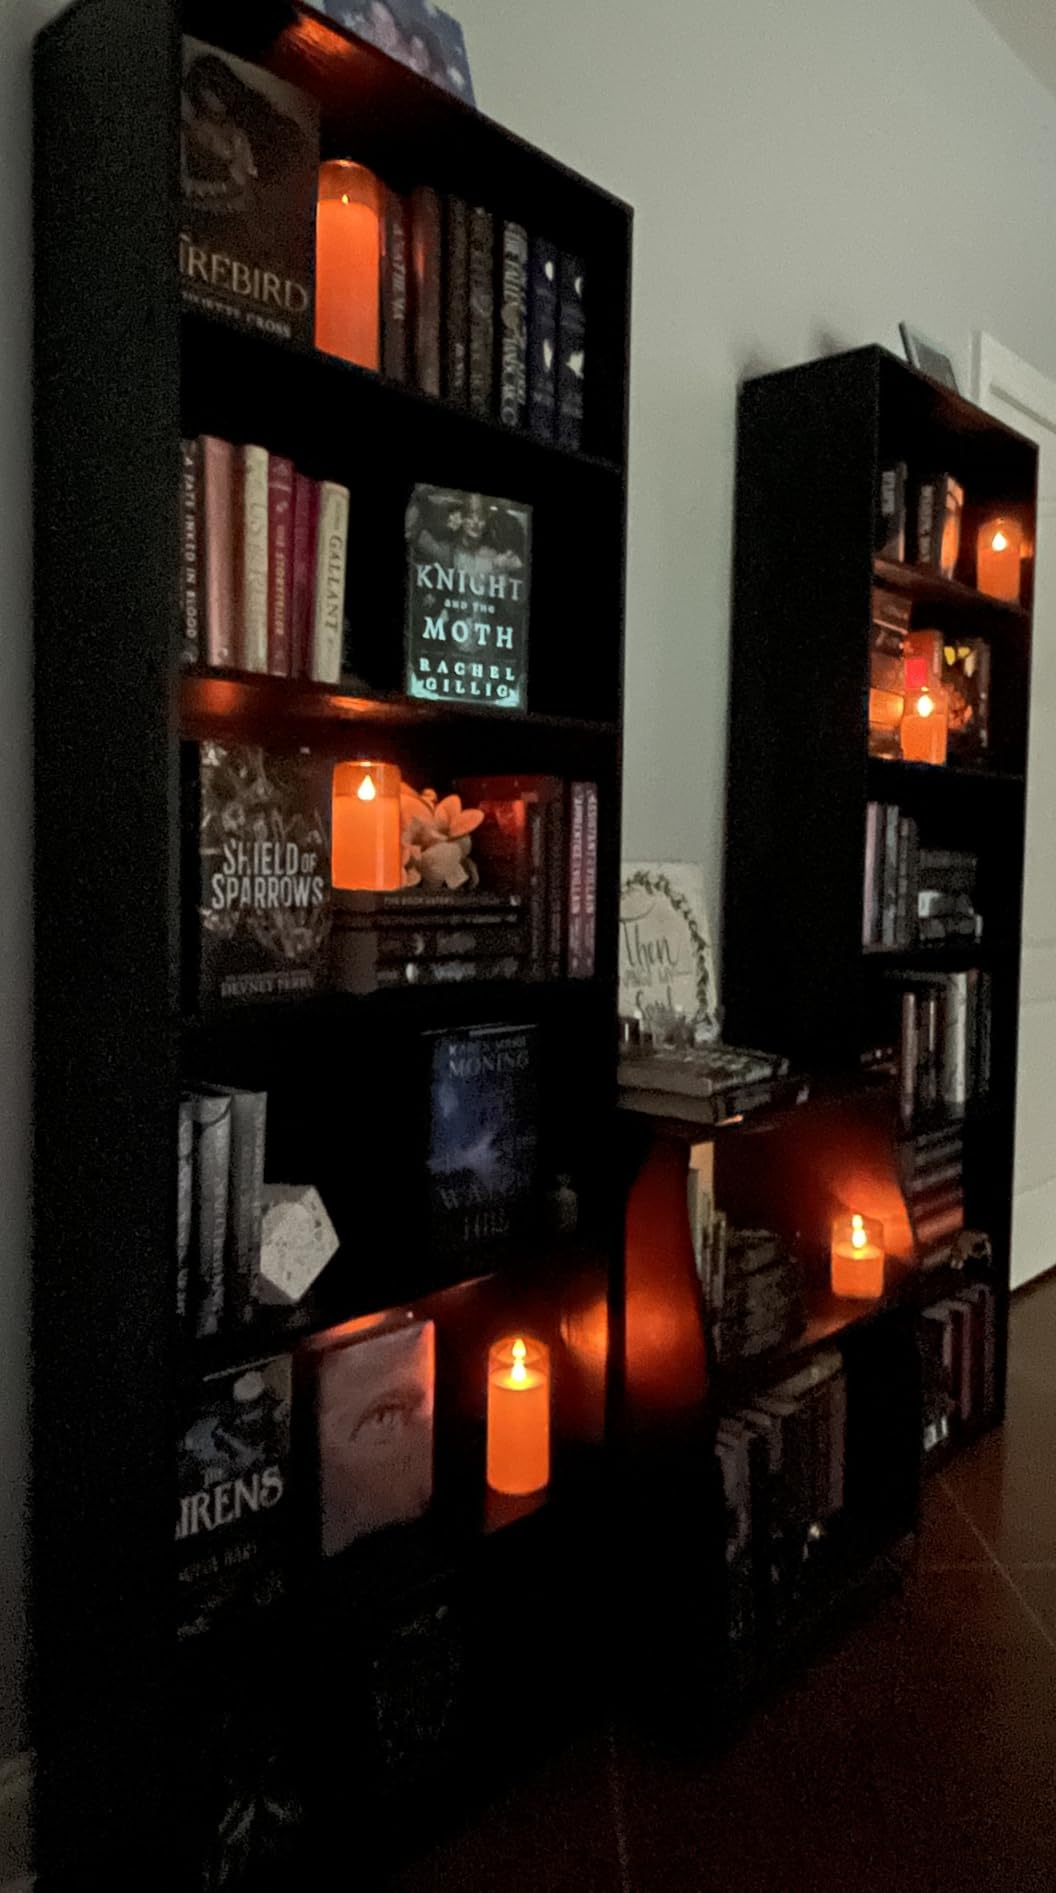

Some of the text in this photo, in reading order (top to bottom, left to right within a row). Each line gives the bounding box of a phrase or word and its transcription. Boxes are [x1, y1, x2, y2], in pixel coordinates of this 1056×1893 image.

[179, 232, 309, 313] IREBIRD
[186, 567, 197, 585] IN
[324, 534, 344, 632] GALLANT
[416, 562, 523, 601] KNIGHT
[186, 590, 198, 640] BLOOD
[444, 598, 468, 611] AND
[421, 616, 514, 649] MOTH
[419, 657, 515, 681] RACHEL
[425, 678, 511, 699] GILLIG
[223, 838, 317, 876] SHIELD OF
[211, 873, 325, 910] SPARROWS
